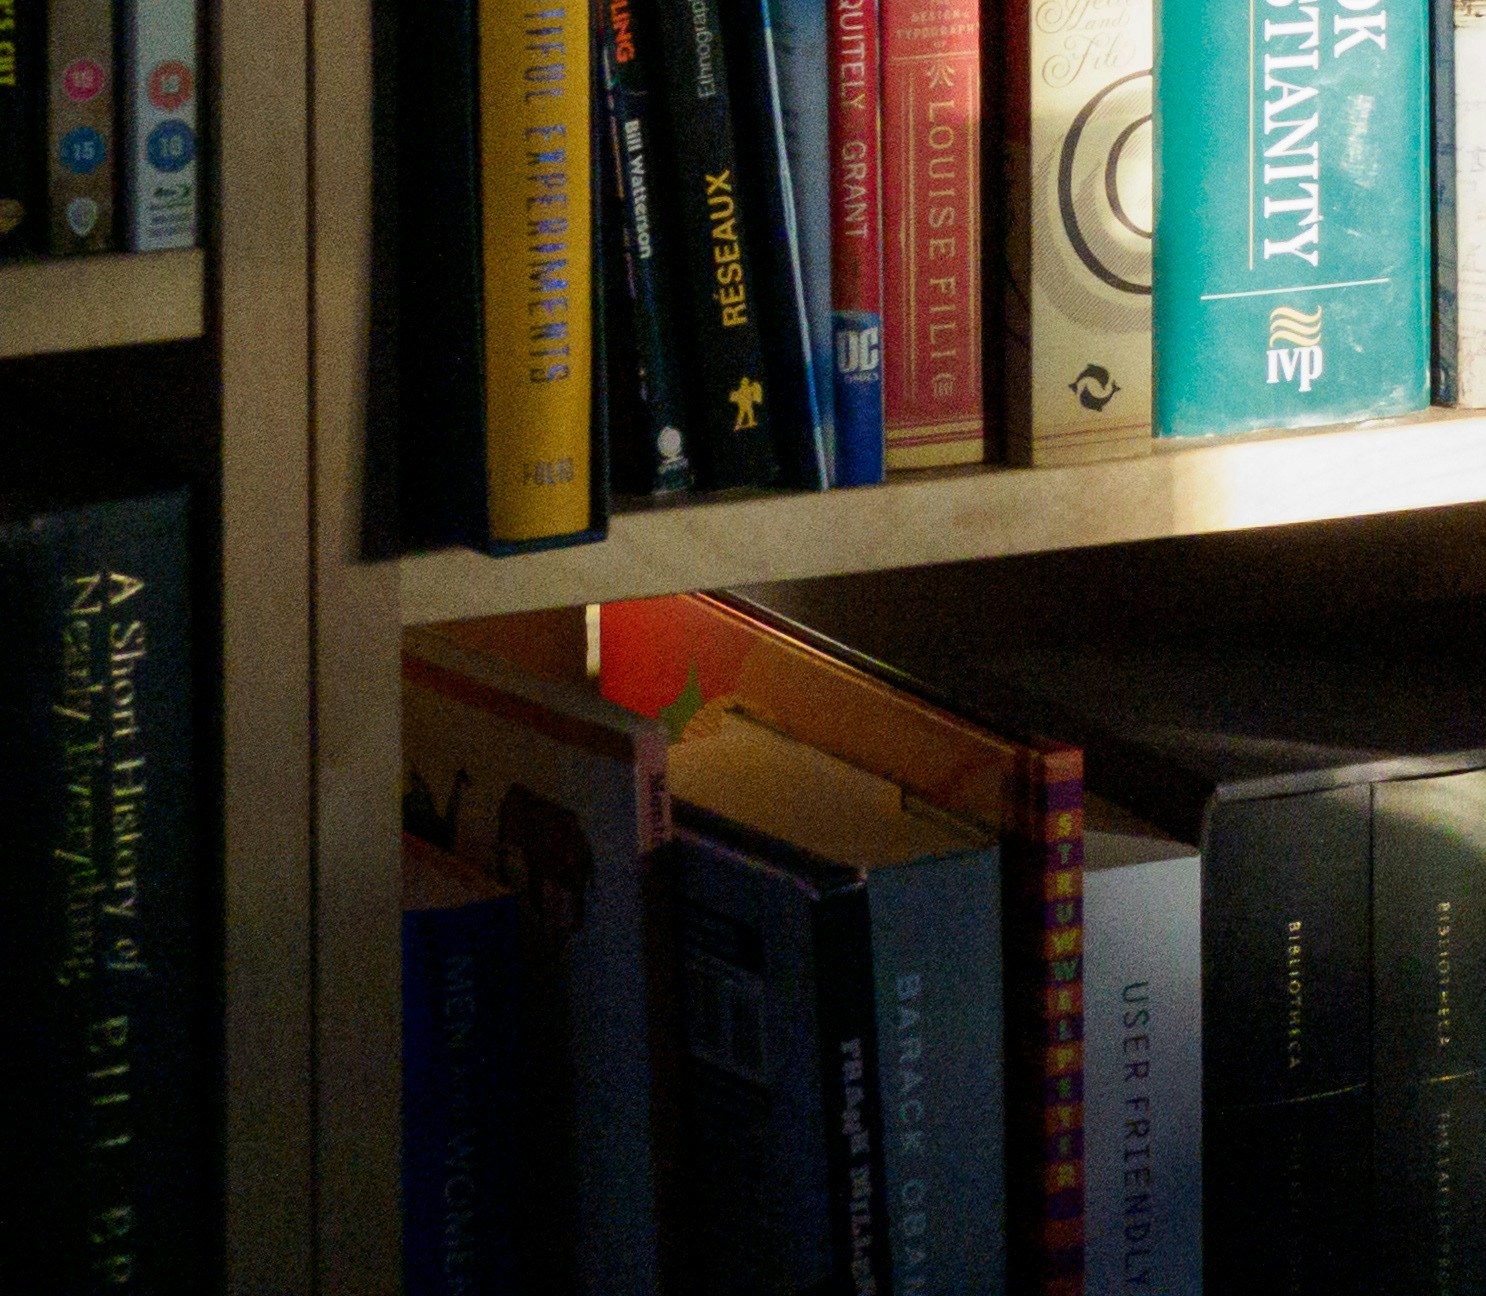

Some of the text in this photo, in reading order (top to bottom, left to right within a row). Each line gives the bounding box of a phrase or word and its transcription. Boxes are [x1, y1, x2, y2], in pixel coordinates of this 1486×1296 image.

[526, 124, 571, 385] EXPERIMENTS
[623, 119, 654, 260] Bill Watterson
[702, 169, 751, 328] RÉSEAUX
[842, 140, 868, 239] GRANT
[926, 101, 956, 260] LOUISE
[928, 276, 956, 361] FILI
[52, 573, 108, 986] Nearly Everything
[100, 571, 149, 976] A Short History of
[892, 974, 925, 1151] BARACK
[1120, 981, 1152, 1287] USER FRIENDLY
